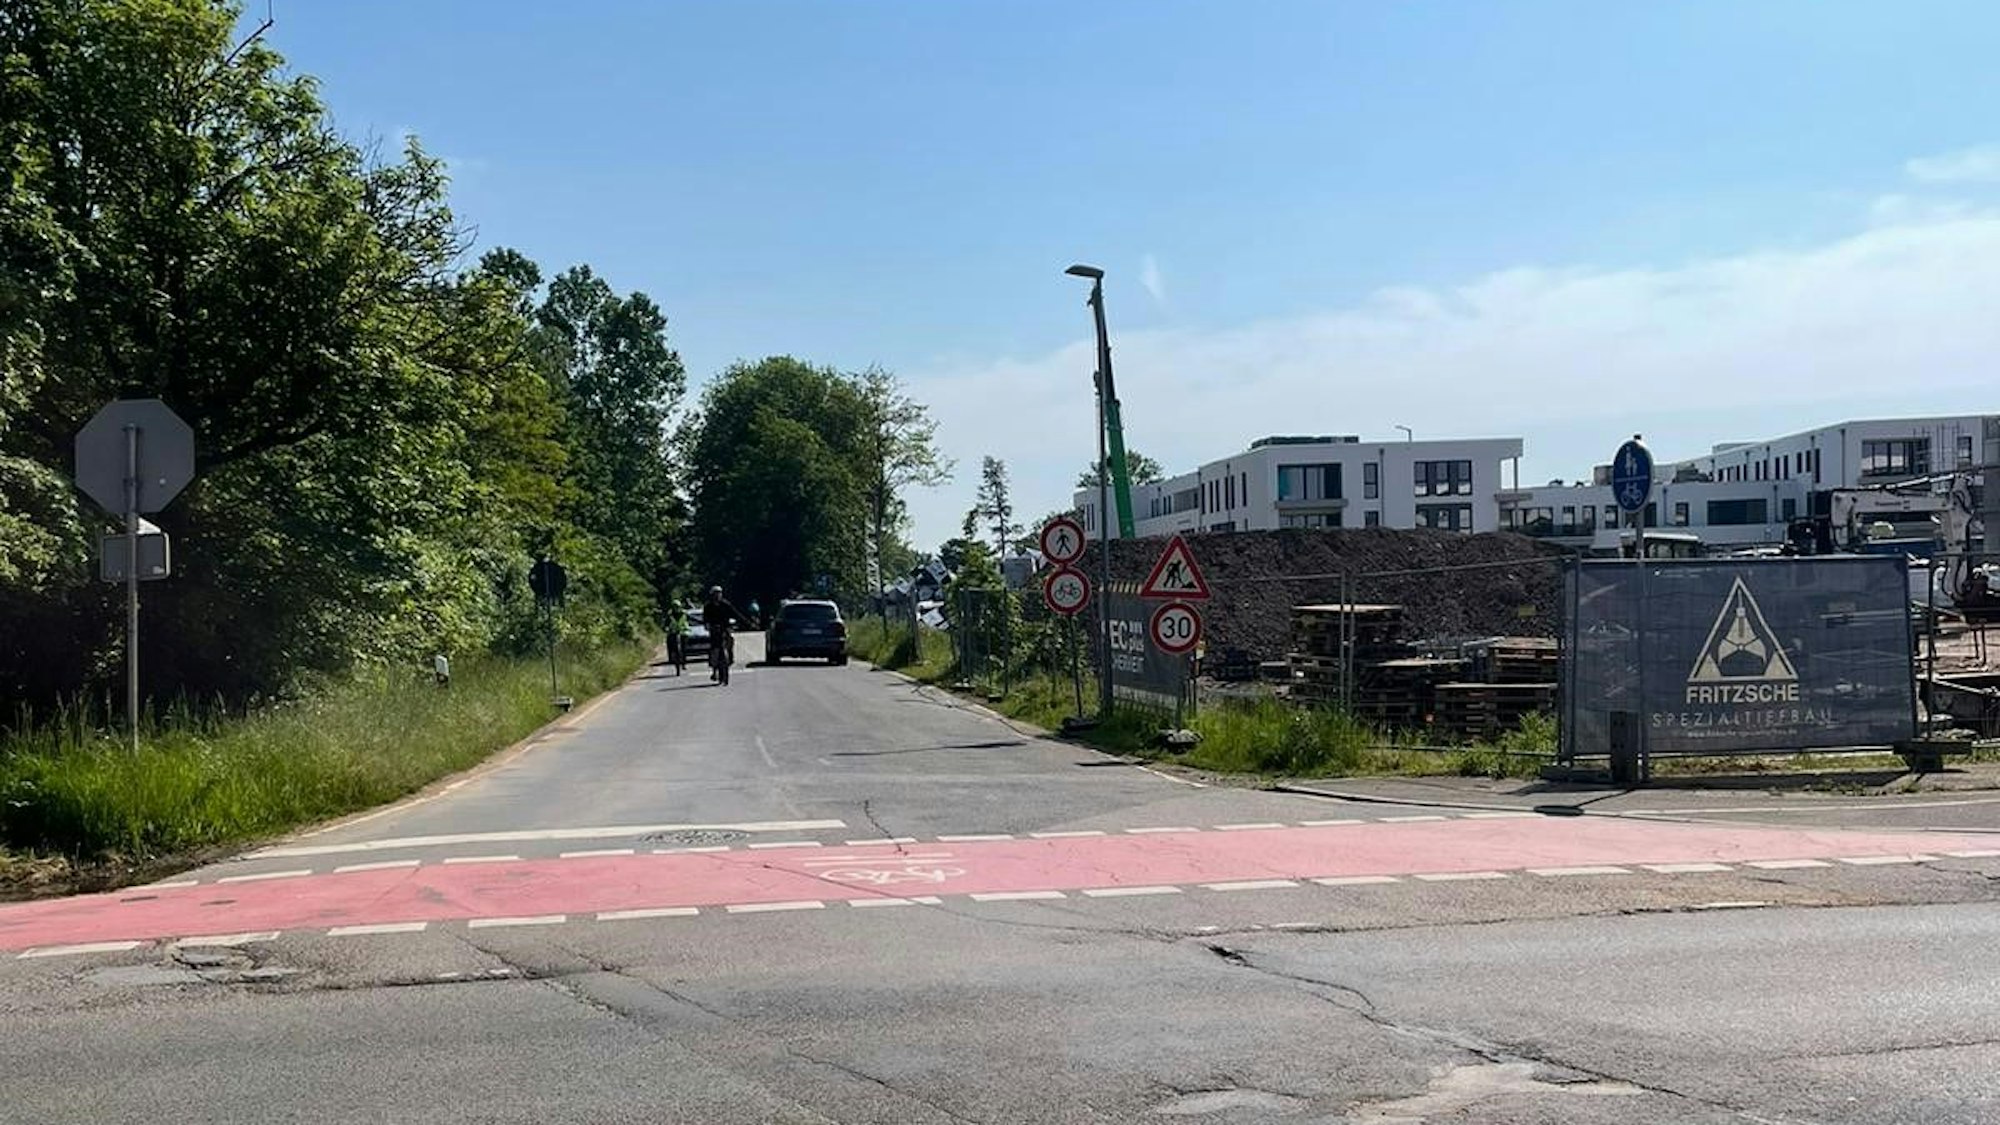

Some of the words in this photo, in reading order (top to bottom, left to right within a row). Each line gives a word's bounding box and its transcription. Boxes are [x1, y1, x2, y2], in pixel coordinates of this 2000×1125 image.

[1162, 617, 1191, 639] 30
[1685, 684, 1800, 704] FRITZSCHE
[1652, 708, 1833, 728] SPEZIALTIEFBAU
